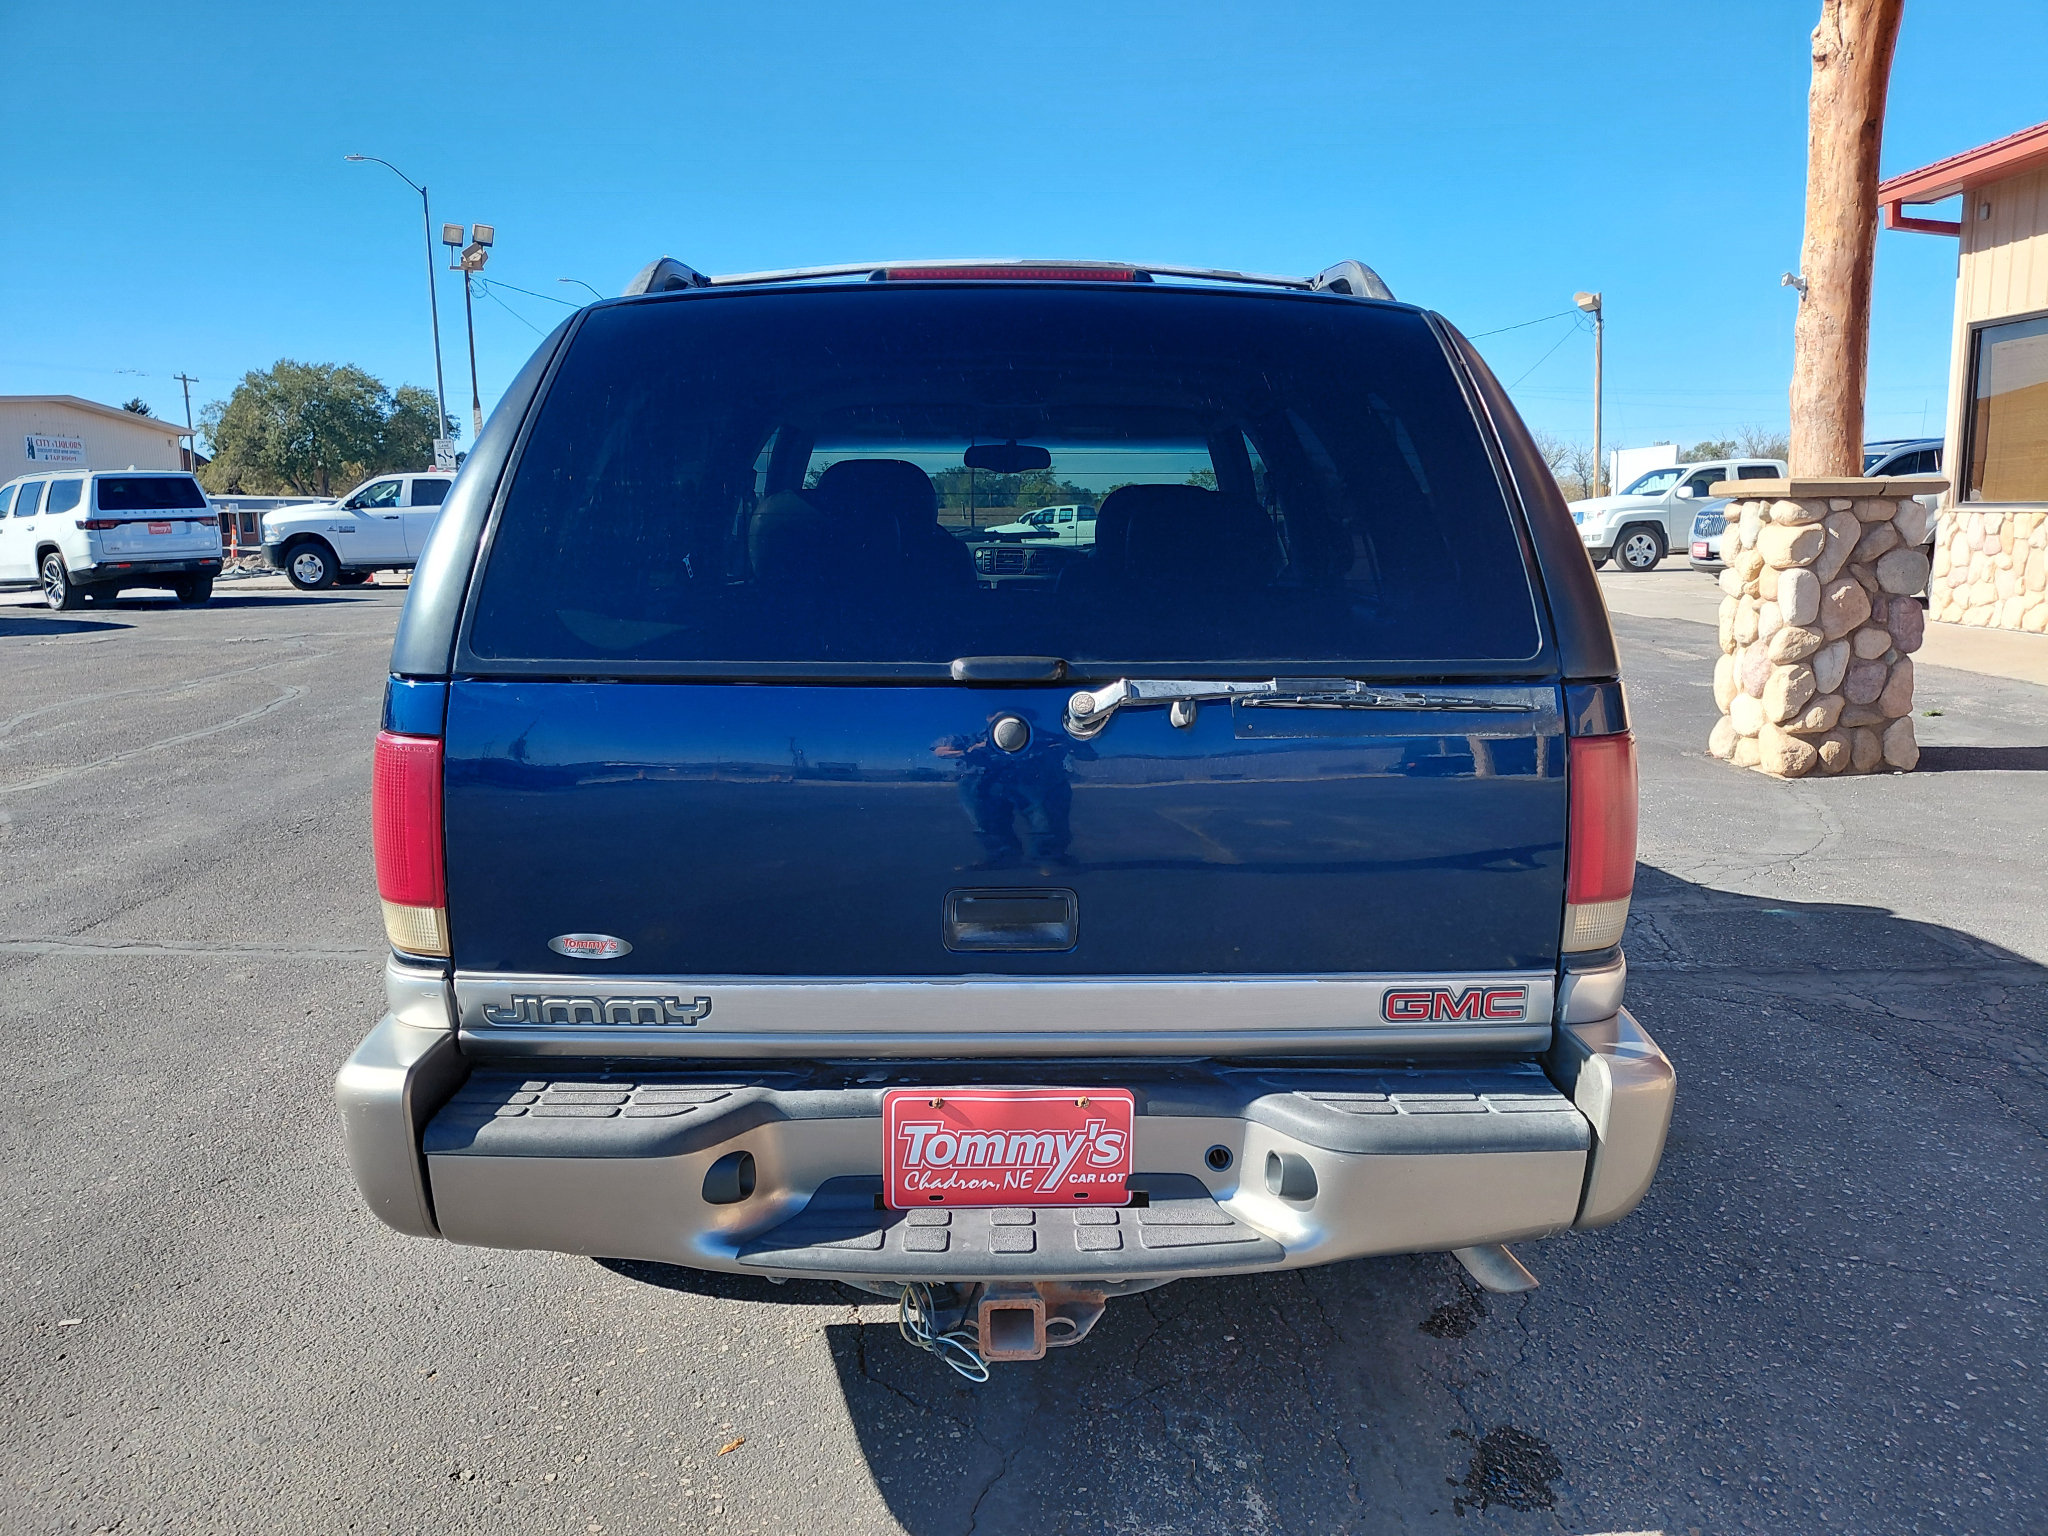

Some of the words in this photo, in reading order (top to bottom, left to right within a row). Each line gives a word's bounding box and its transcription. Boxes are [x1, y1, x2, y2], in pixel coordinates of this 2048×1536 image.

[35, 438, 50, 448] CITY
[562, 938, 617, 955] Tommy's
[1382, 985, 1528, 1023] GMC
[898, 1118, 1127, 1194] Tommy's
[903, 1168, 1001, 1191] Chadron,
[1003, 1169, 1034, 1190] NE
[1068, 1173, 1096, 1184] CAR
[1099, 1172, 1126, 1183] LOT
